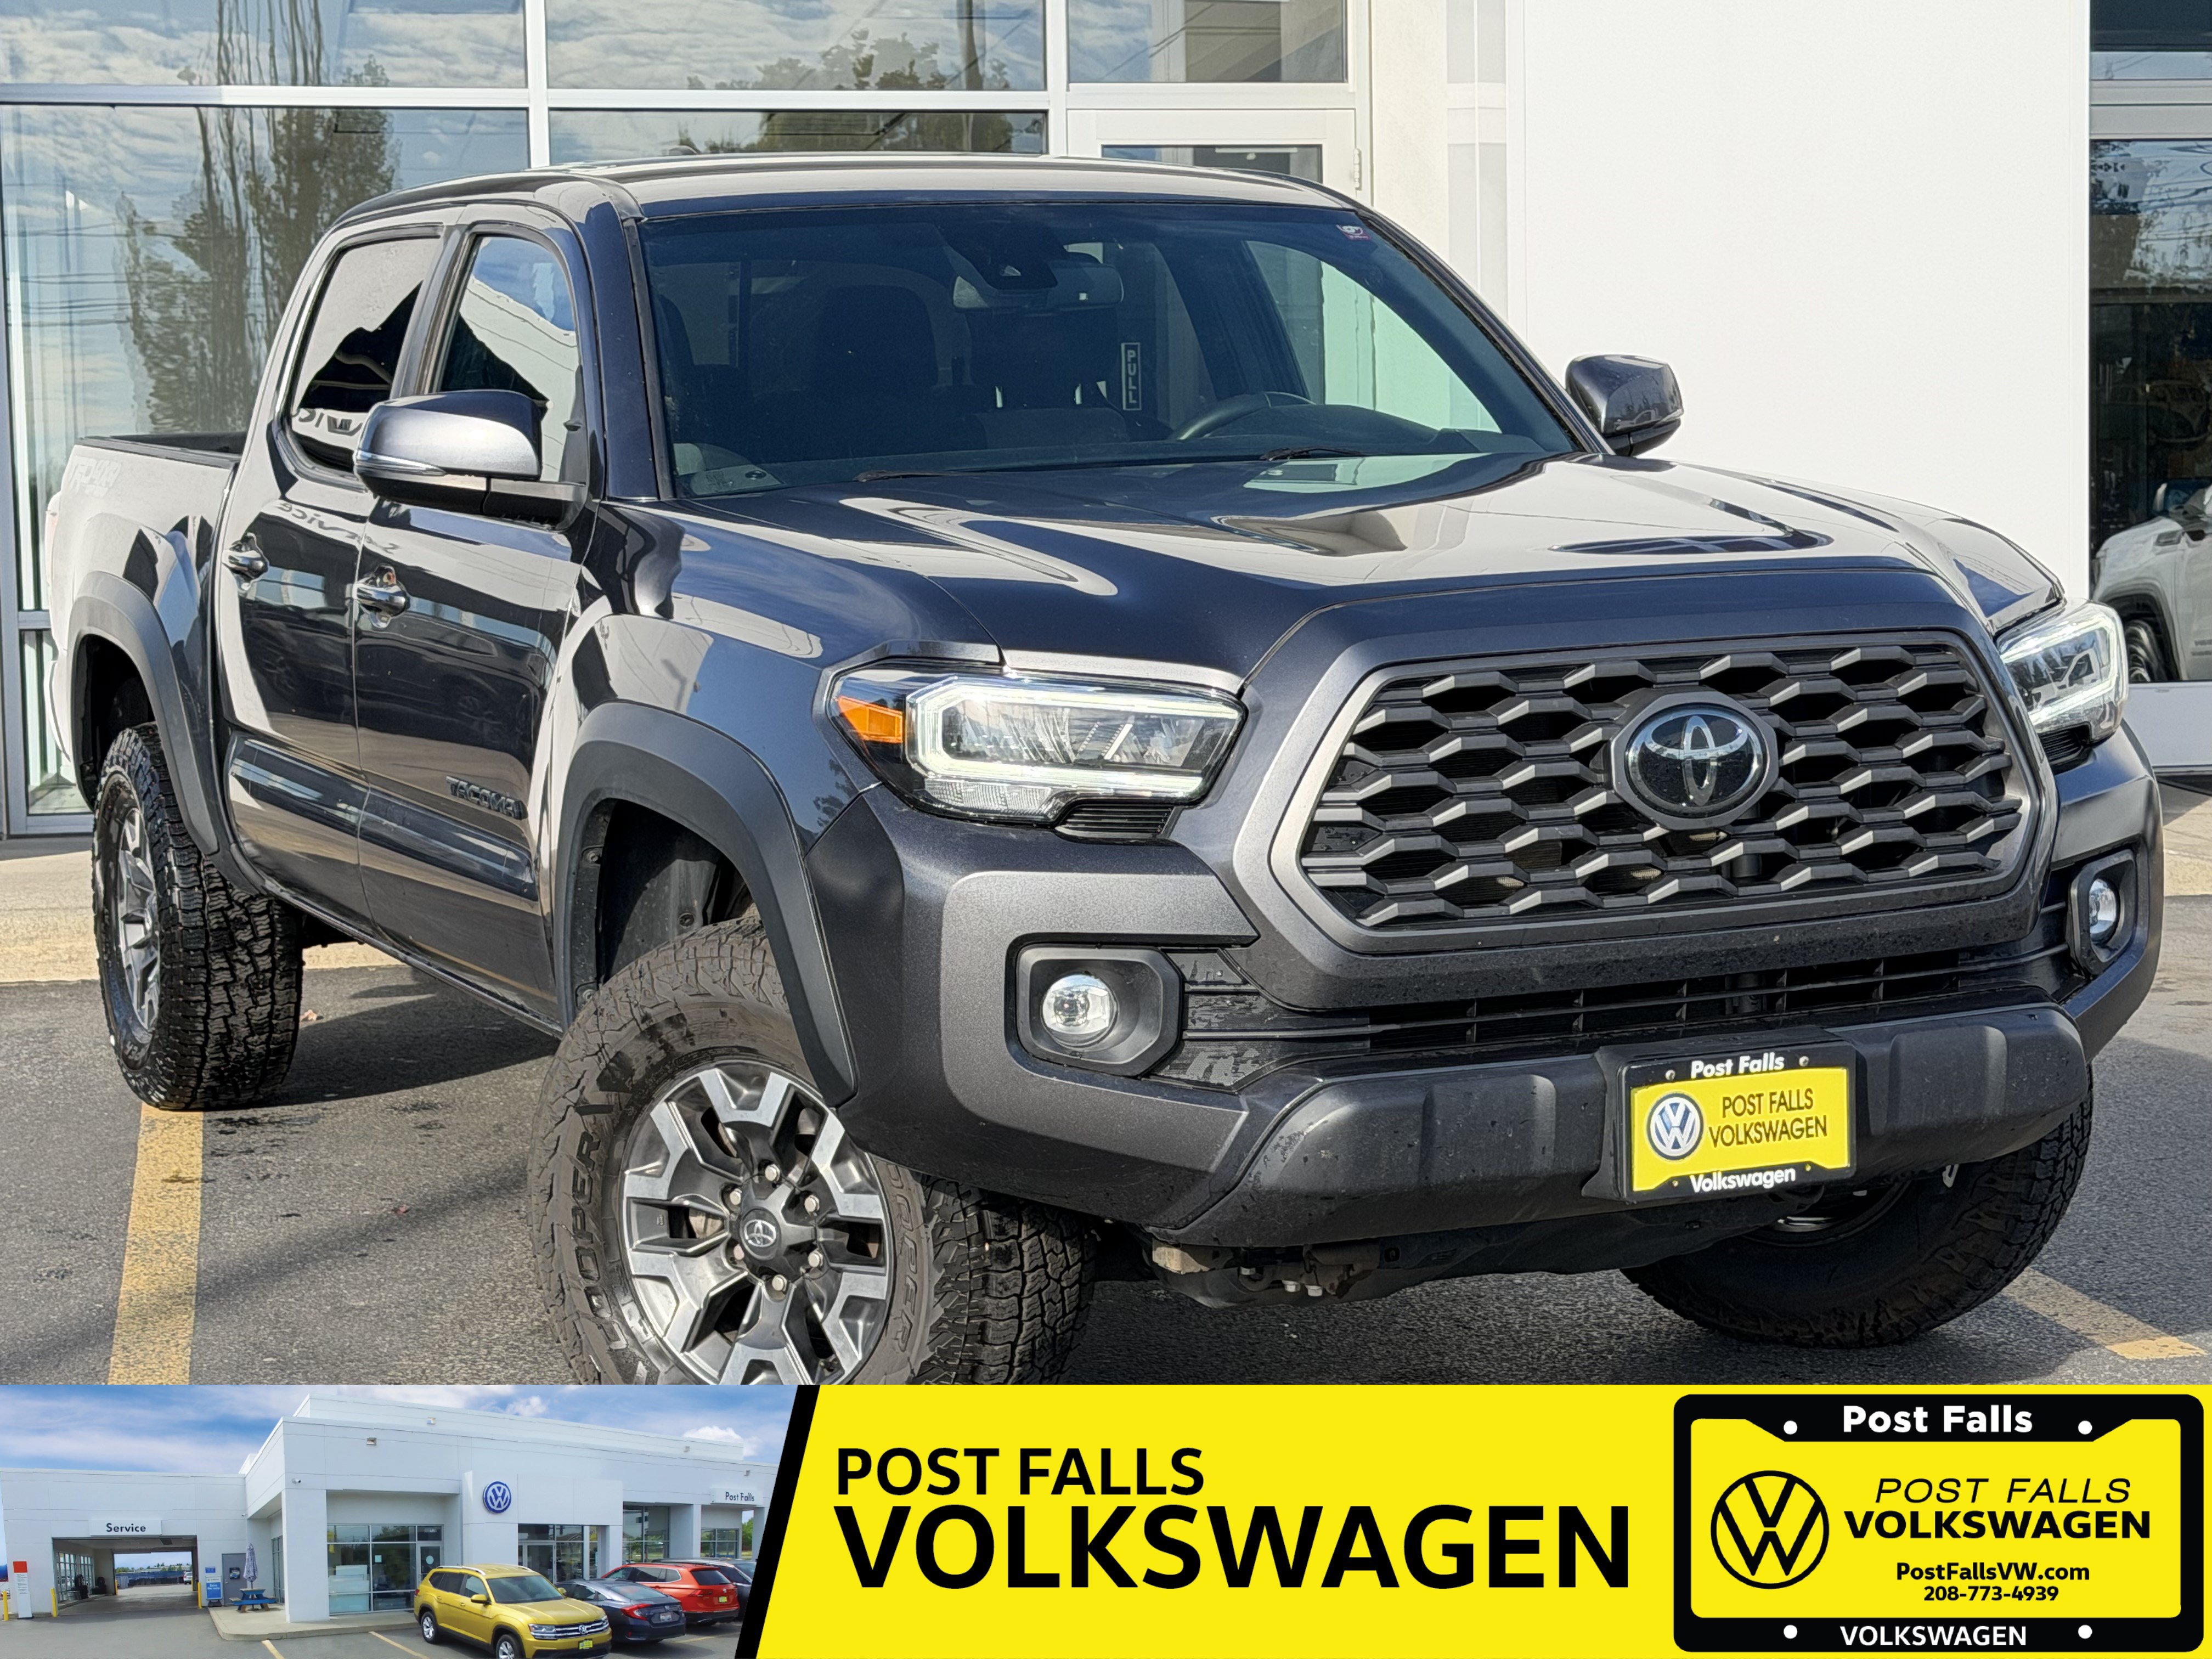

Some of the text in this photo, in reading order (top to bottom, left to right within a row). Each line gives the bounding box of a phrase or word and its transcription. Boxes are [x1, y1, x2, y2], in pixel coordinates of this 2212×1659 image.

[1127, 349, 1137, 403] PULL
[445, 775, 528, 815] TACOMA
[1691, 1052, 1785, 1079] Post Falls
[1722, 1088, 1814, 1119] POST FALLS
[1708, 1114, 1827, 1148] VOLKSWAGEN
[1689, 1167, 1796, 1194] Volkswagen
[725, 1491, 755, 1502] Post Falls
[106, 1522, 146, 1532] Service
